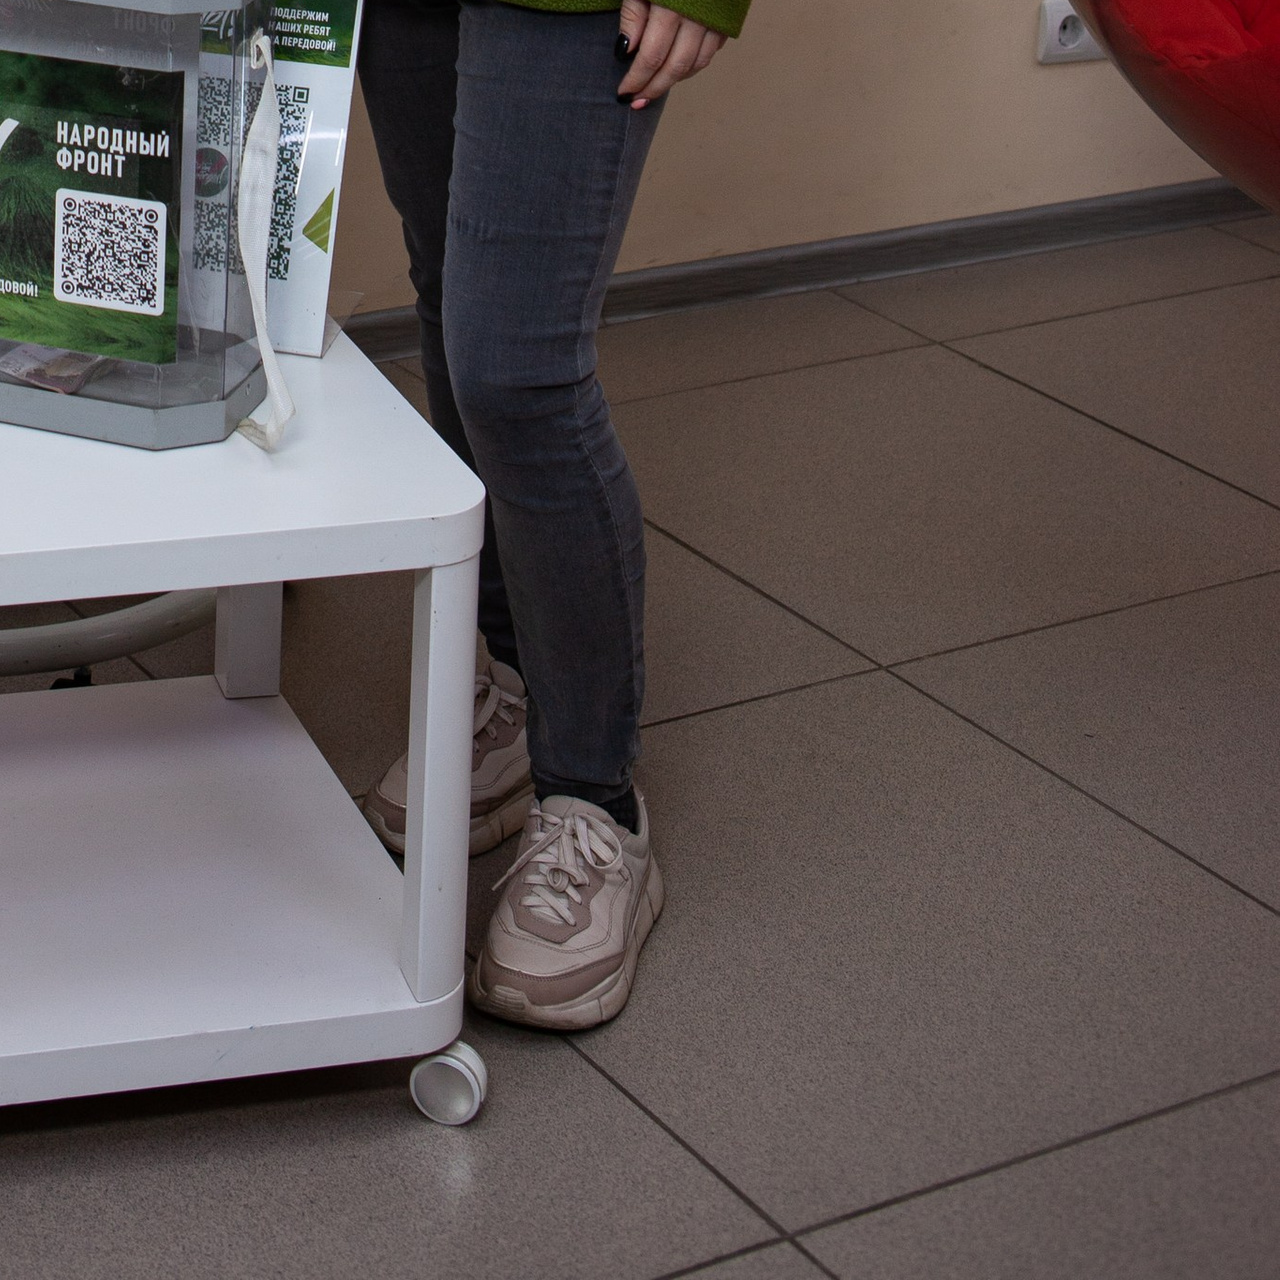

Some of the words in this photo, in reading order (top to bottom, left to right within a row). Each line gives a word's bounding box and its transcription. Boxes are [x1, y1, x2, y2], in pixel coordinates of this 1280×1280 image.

[303, 23, 331, 37] РЕБЯТ
[281, 37, 336, 52] ПЕРЕДОВОЙ!
[56, 120, 170, 159] НАРОДНЫЙ
[56, 147, 126, 179] ФРОНТ
